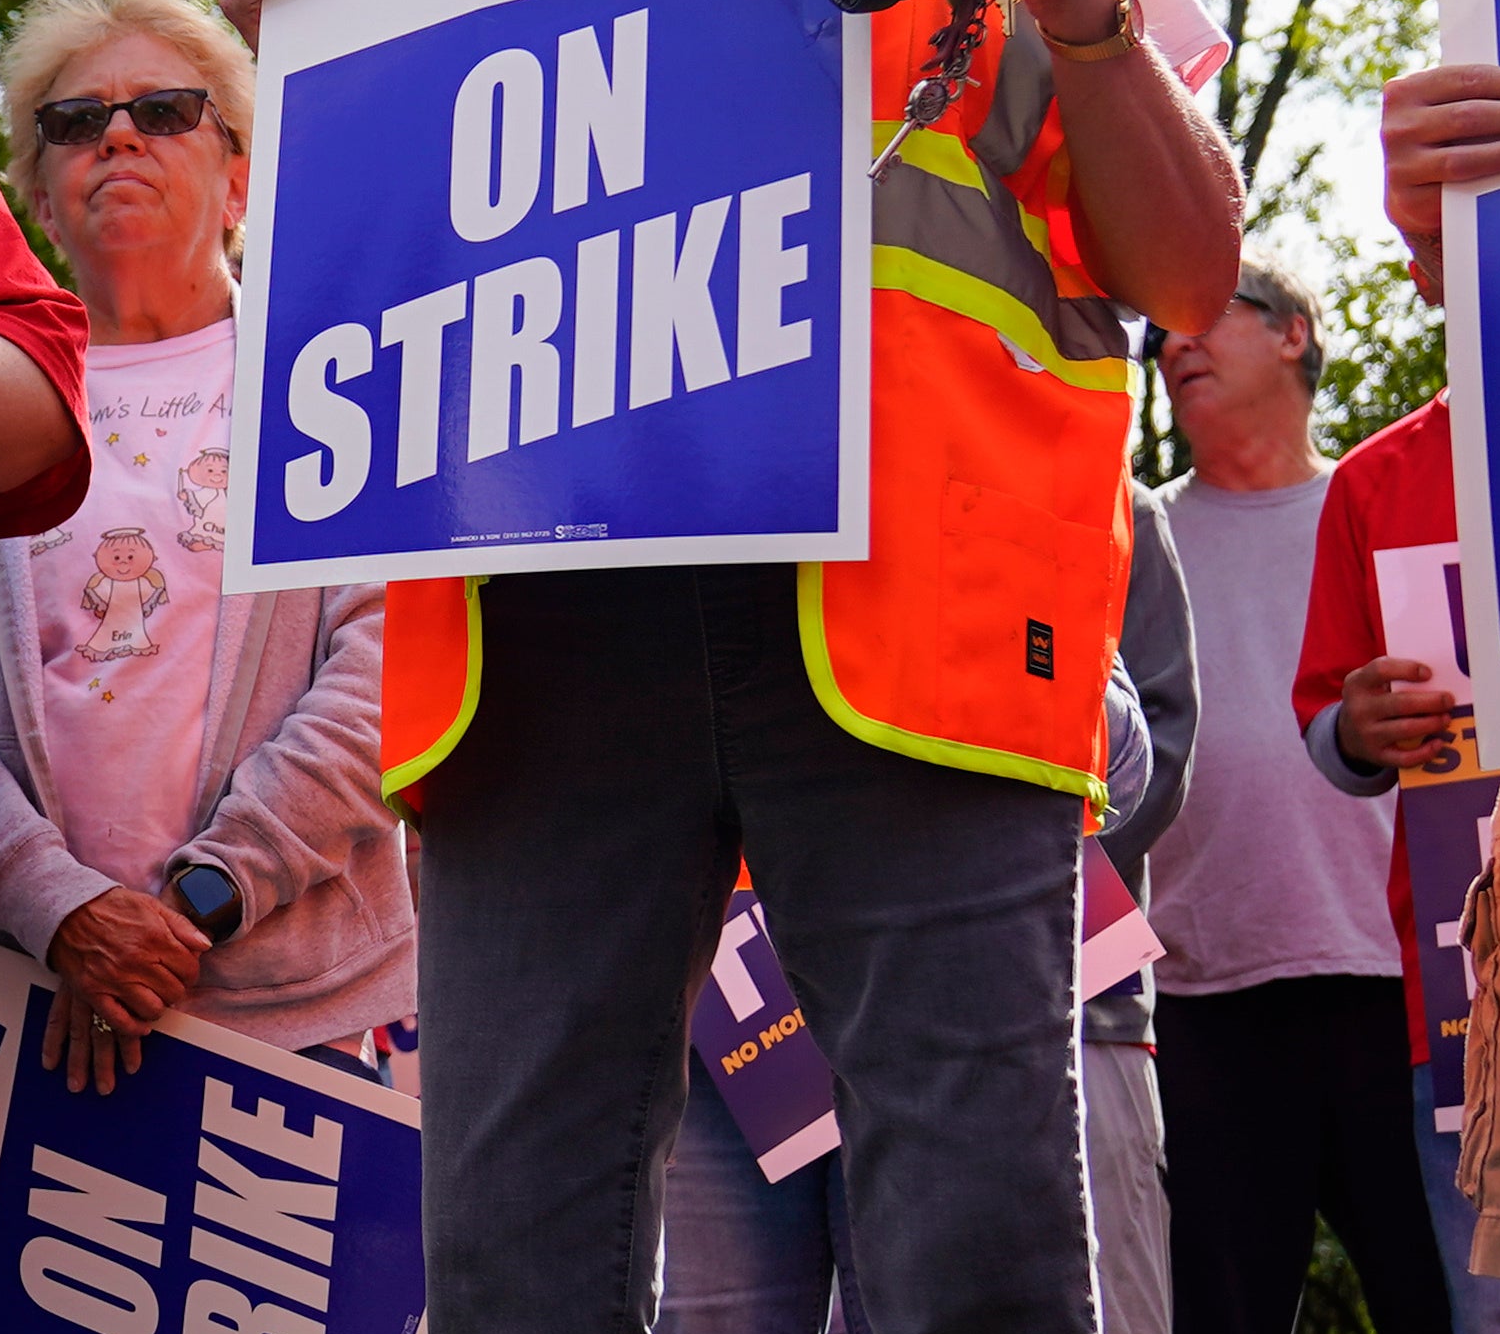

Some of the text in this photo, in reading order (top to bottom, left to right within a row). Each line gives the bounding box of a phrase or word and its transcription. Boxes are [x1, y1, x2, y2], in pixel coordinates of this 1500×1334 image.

[451, 8, 648, 243] ON
[284, 172, 812, 524] STRIKE
[140, 392, 204, 419] Little
[202, 522, 225, 535] Cha
[721, 1041, 758, 1075] NO
